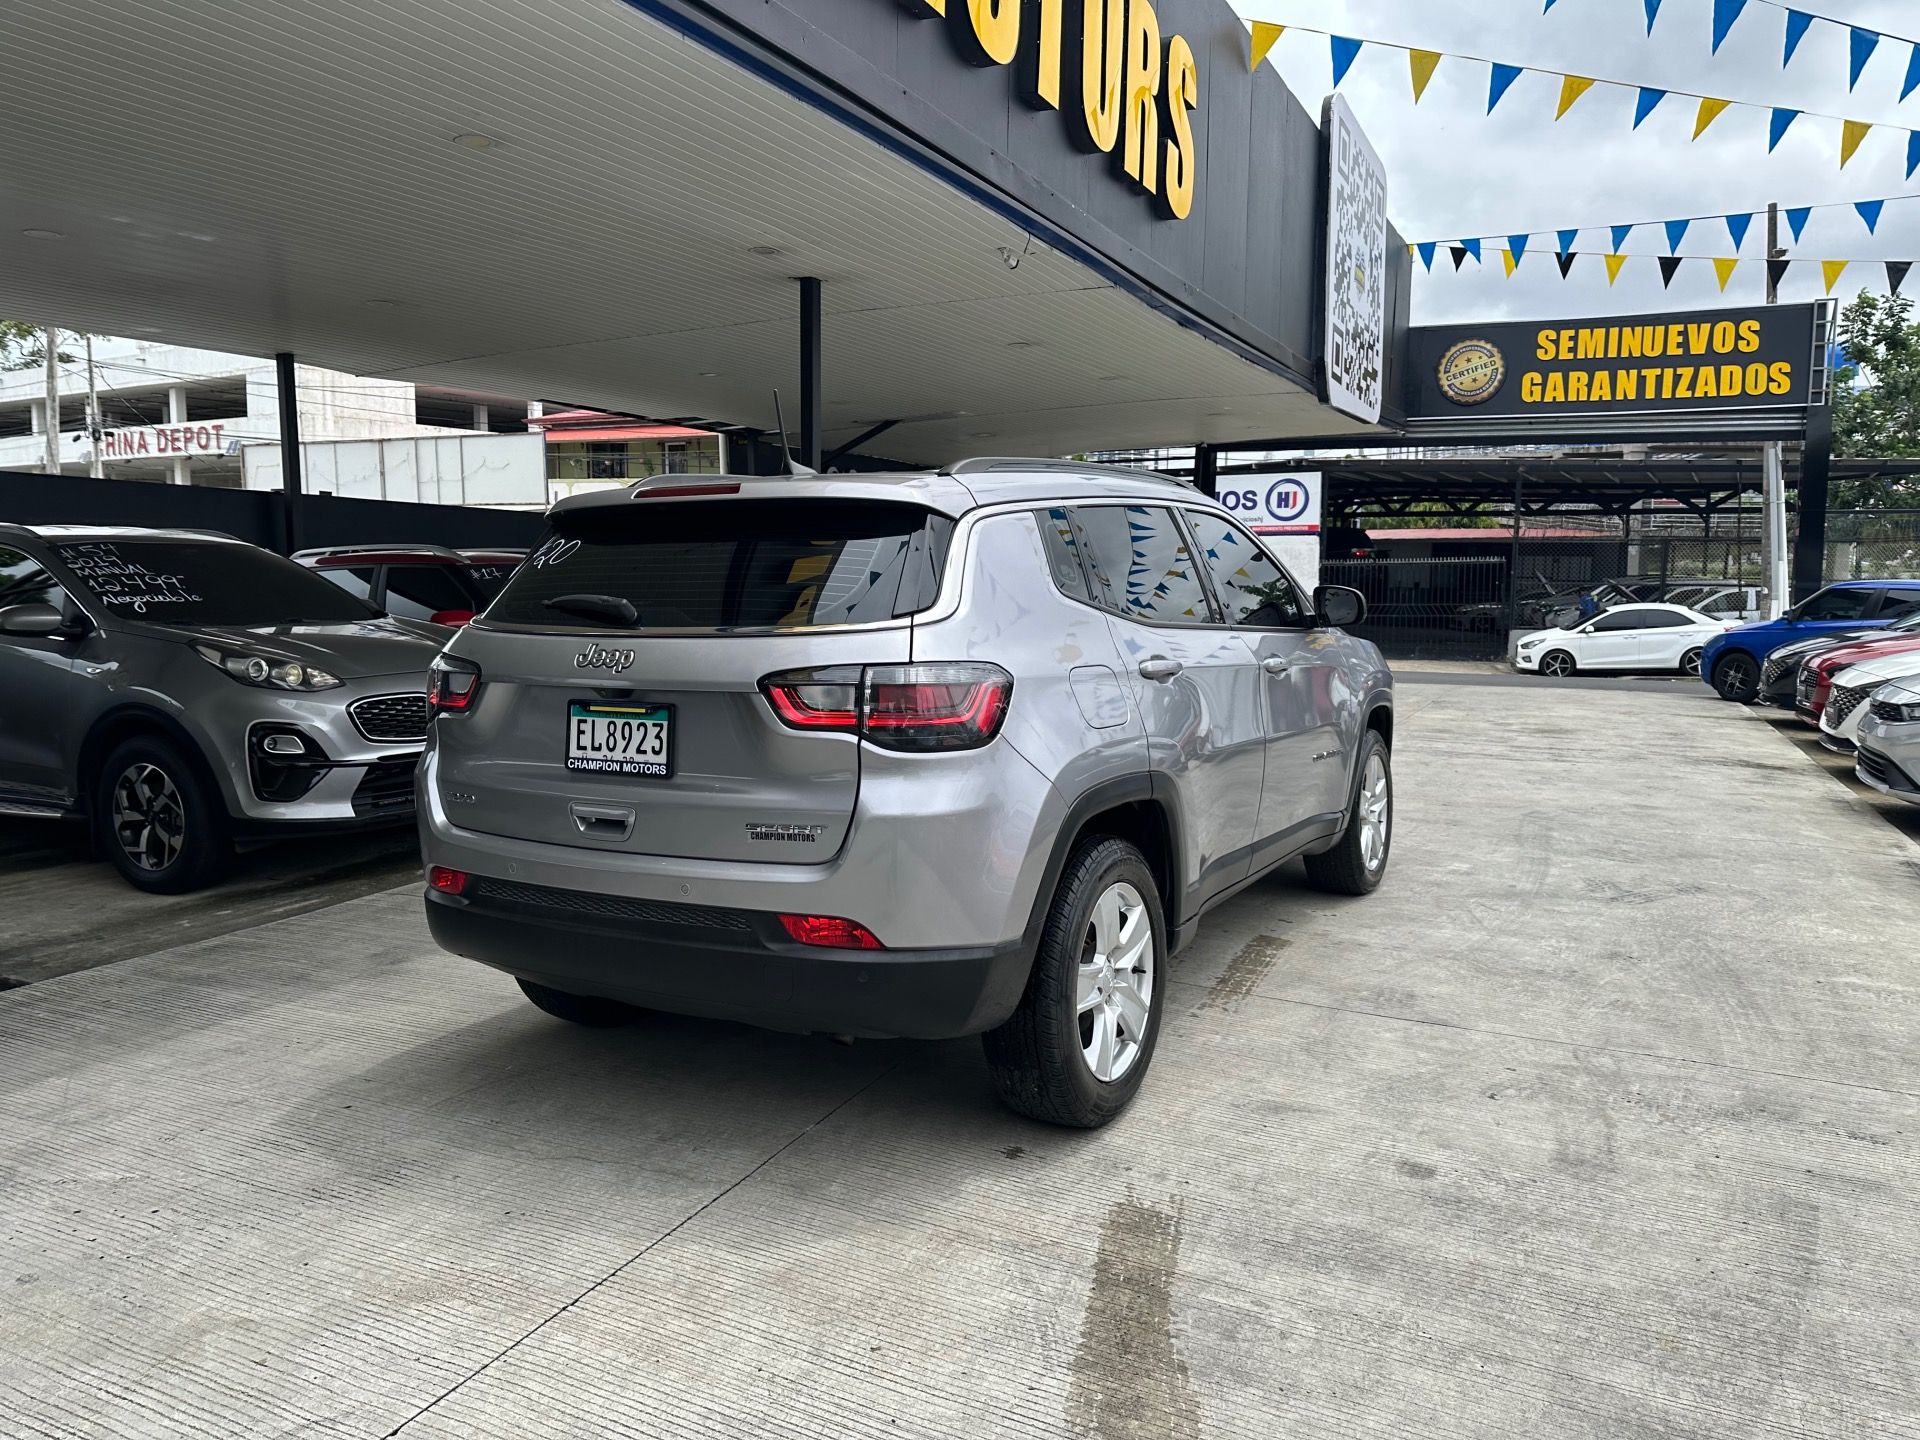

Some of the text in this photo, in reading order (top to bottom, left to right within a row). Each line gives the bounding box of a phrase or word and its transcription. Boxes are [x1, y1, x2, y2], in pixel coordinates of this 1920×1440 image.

[1536, 319, 1761, 361] SEMINUEVOS
[1445, 359, 1497, 382] CERTIFIED
[1521, 361, 1792, 403] GARANTIZADOS
[156, 424, 224, 452] DEPOT
[1276, 490, 1298, 510] HJ
[67, 555, 123, 569] 2019
[74, 563, 156, 577] MANUAL
[470, 567, 503, 580] #17
[574, 643, 635, 675] Jeep
[576, 718, 664, 756] EL8923
[567, 758, 667, 775] CHAMPION MOTORS
[750, 831, 816, 843] CHAMPION MOTORS
